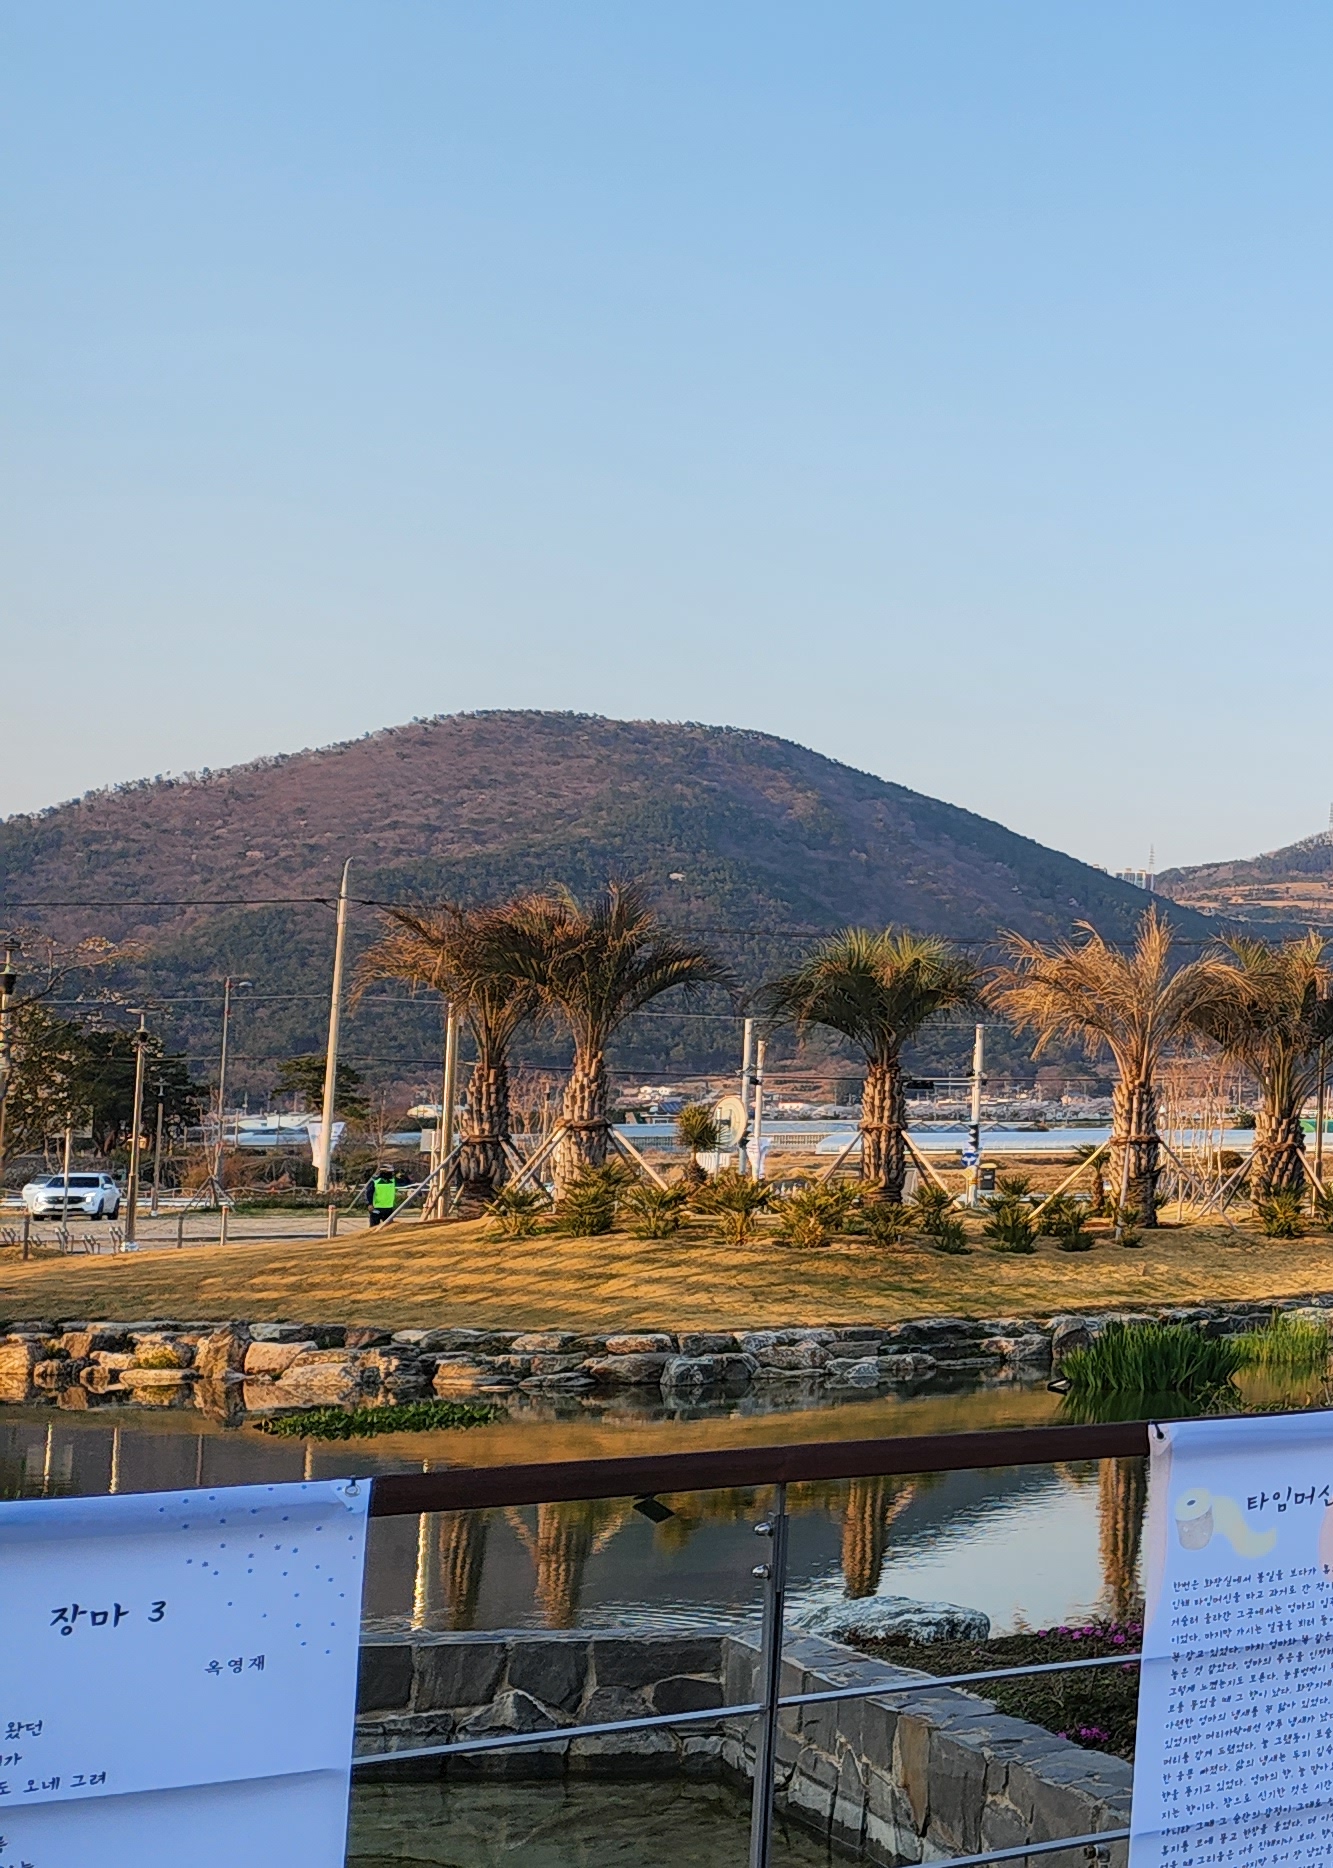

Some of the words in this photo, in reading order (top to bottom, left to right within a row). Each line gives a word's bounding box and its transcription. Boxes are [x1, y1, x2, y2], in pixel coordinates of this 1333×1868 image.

[50, 1602, 129, 1636] 장마
[147, 1600, 167, 1623] 3
[204, 1654, 266, 1677] 옥영재
[4, 1719, 43, 1740] 왔던
[0, 1752, 22, 1767] 가
[23, 1776, 61, 1793] 오네
[69, 1771, 107, 1788] 그려
